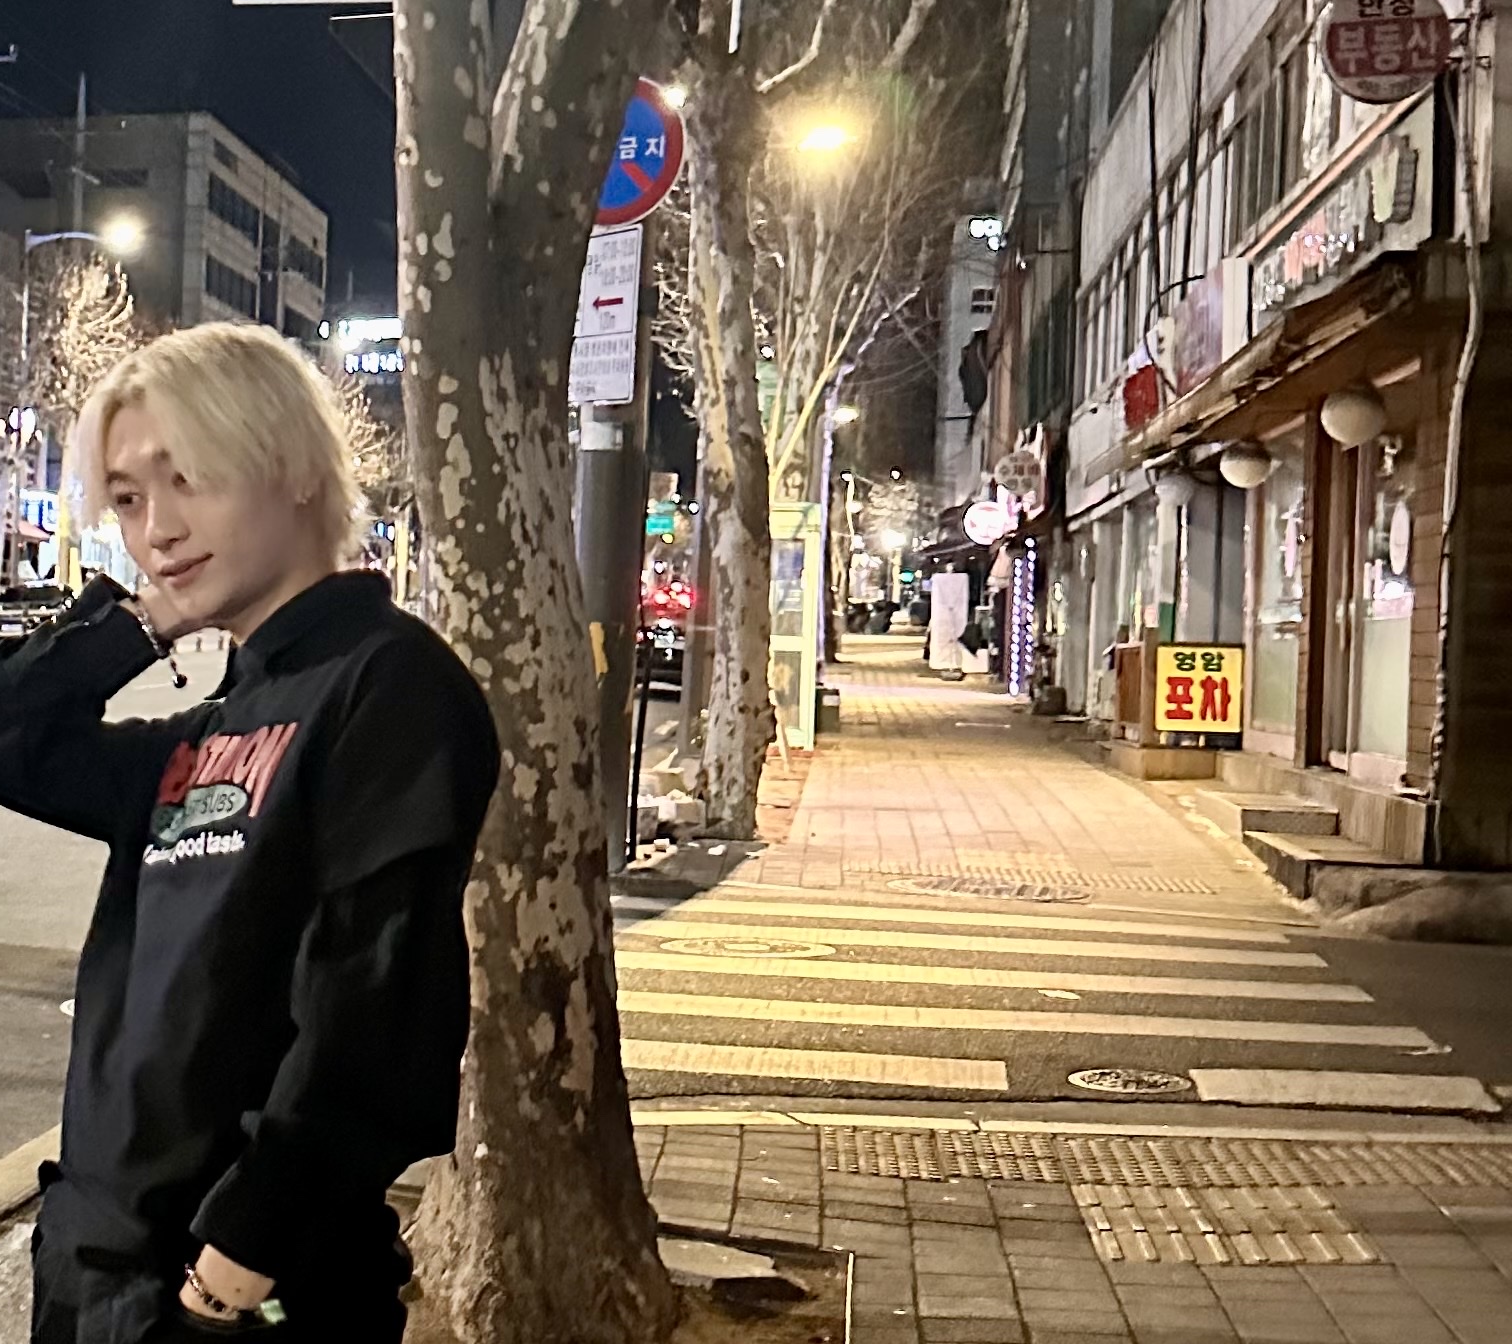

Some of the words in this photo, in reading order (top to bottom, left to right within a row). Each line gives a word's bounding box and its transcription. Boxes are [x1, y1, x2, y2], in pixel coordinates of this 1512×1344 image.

[1334, 19, 1439, 76] 부동산
[1173, 651, 1226, 672] 영암
[1164, 675, 1232, 722] 포차
